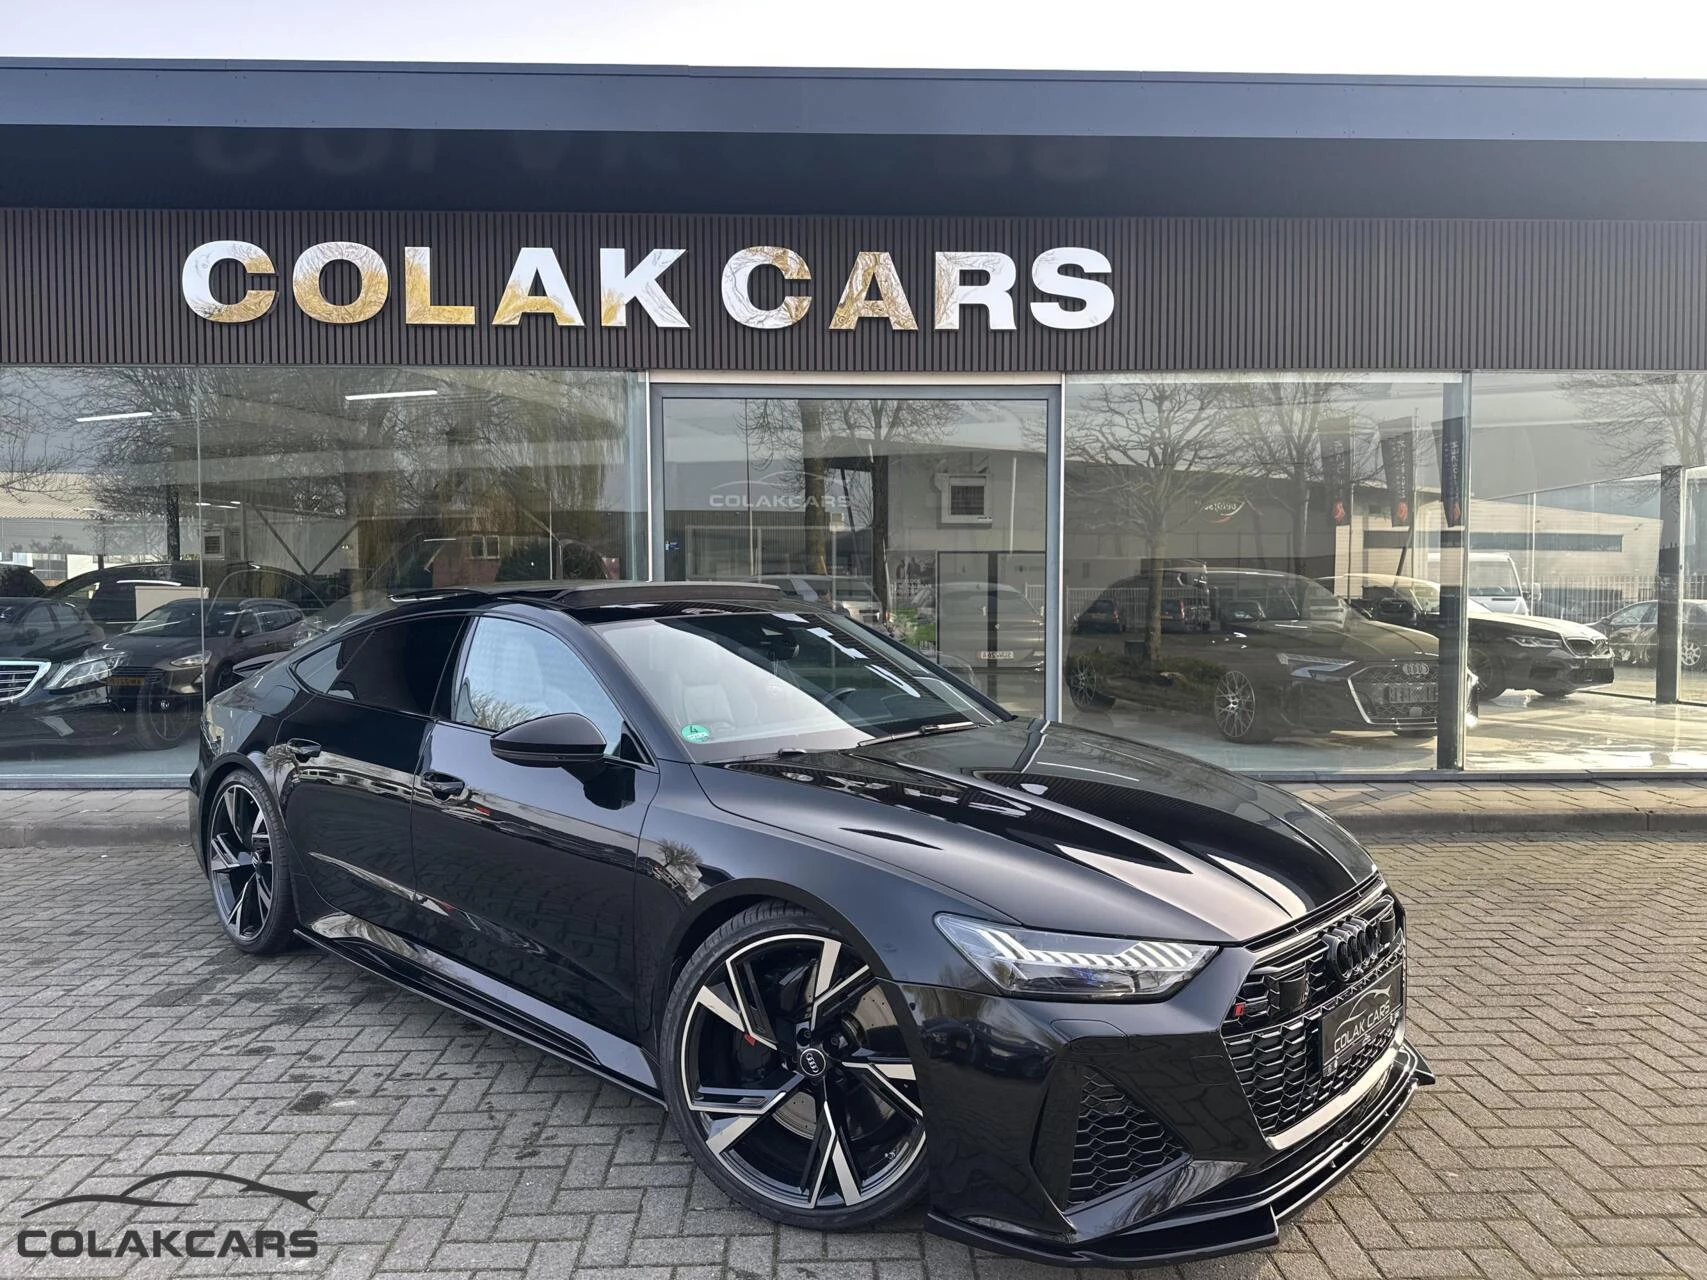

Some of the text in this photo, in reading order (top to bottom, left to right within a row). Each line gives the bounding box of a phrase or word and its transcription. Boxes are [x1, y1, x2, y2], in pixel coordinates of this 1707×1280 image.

[182, 239, 1116, 332] COLAK CARS
[709, 495, 849, 508] COLAKCARS
[1334, 1001, 1391, 1053] COLAK CARS
